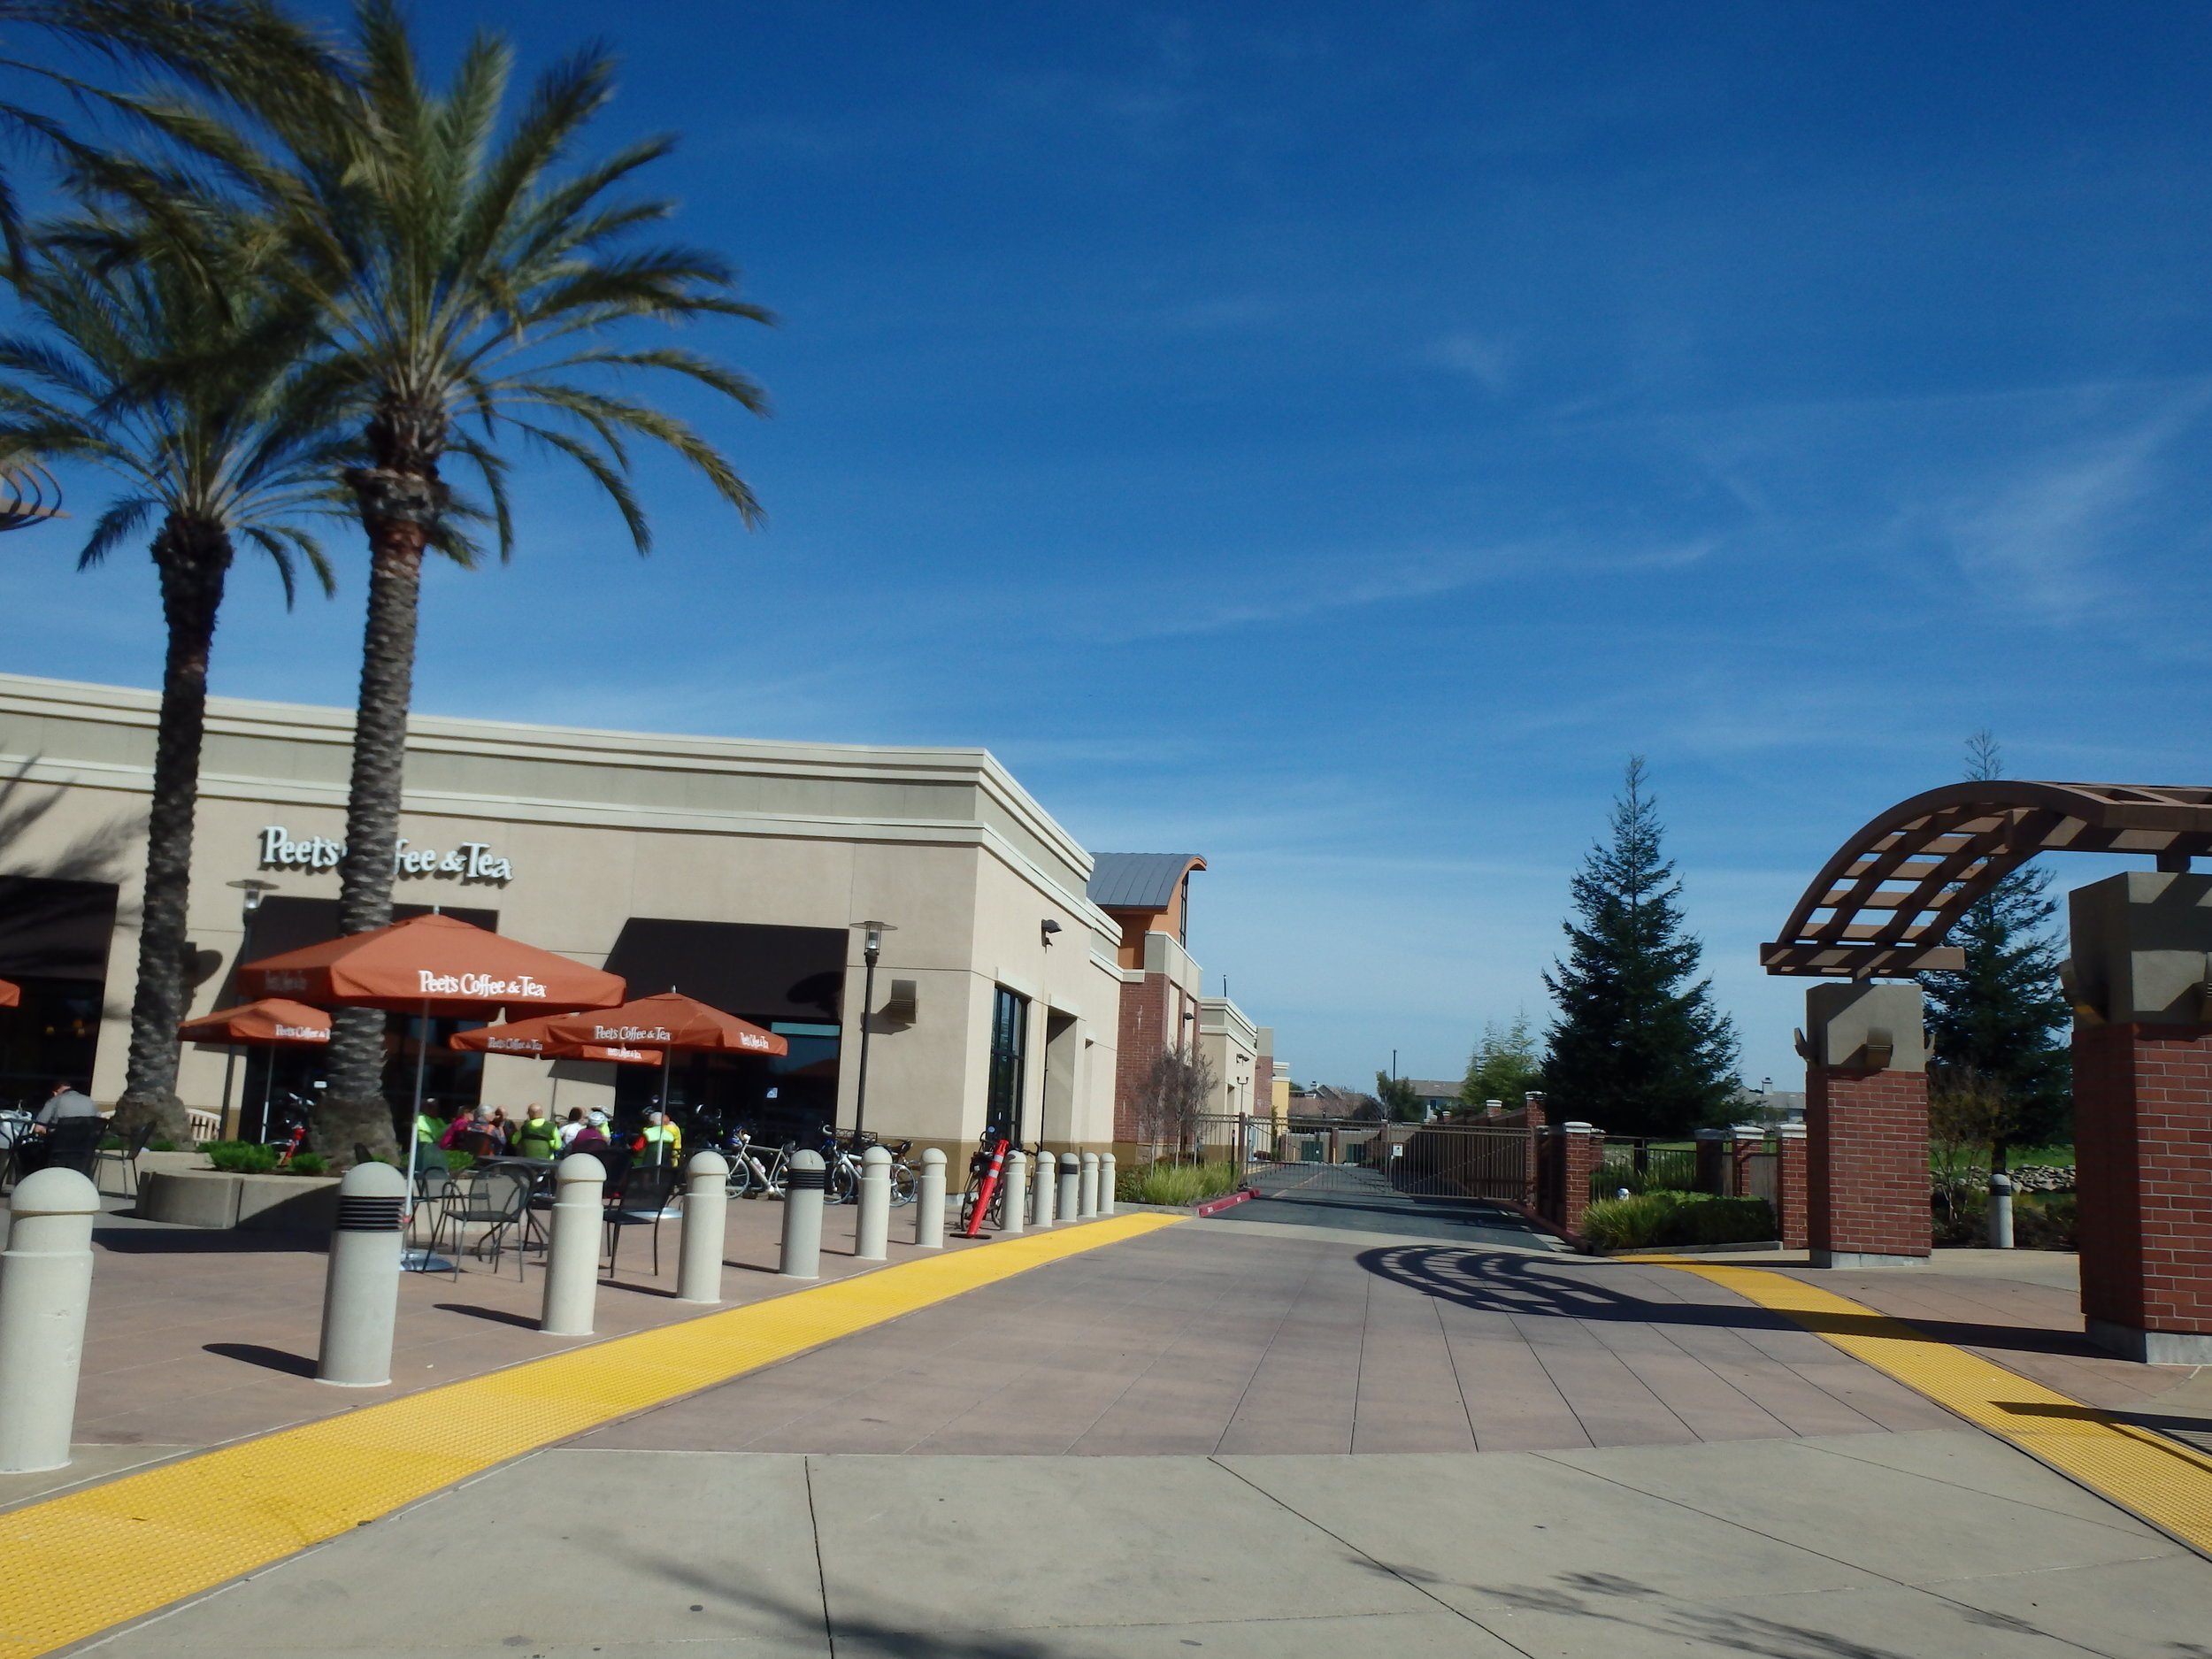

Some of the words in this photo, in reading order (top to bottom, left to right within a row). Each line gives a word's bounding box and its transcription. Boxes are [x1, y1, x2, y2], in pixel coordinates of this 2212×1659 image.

[461, 841, 512, 880] Tea
[460, 972, 506, 997] Coffee
[506, 980, 521, 994] &
[518, 975, 546, 998] Tea
[619, 1025, 647, 1041] Coffee
[655, 1026, 671, 1041] Tea
